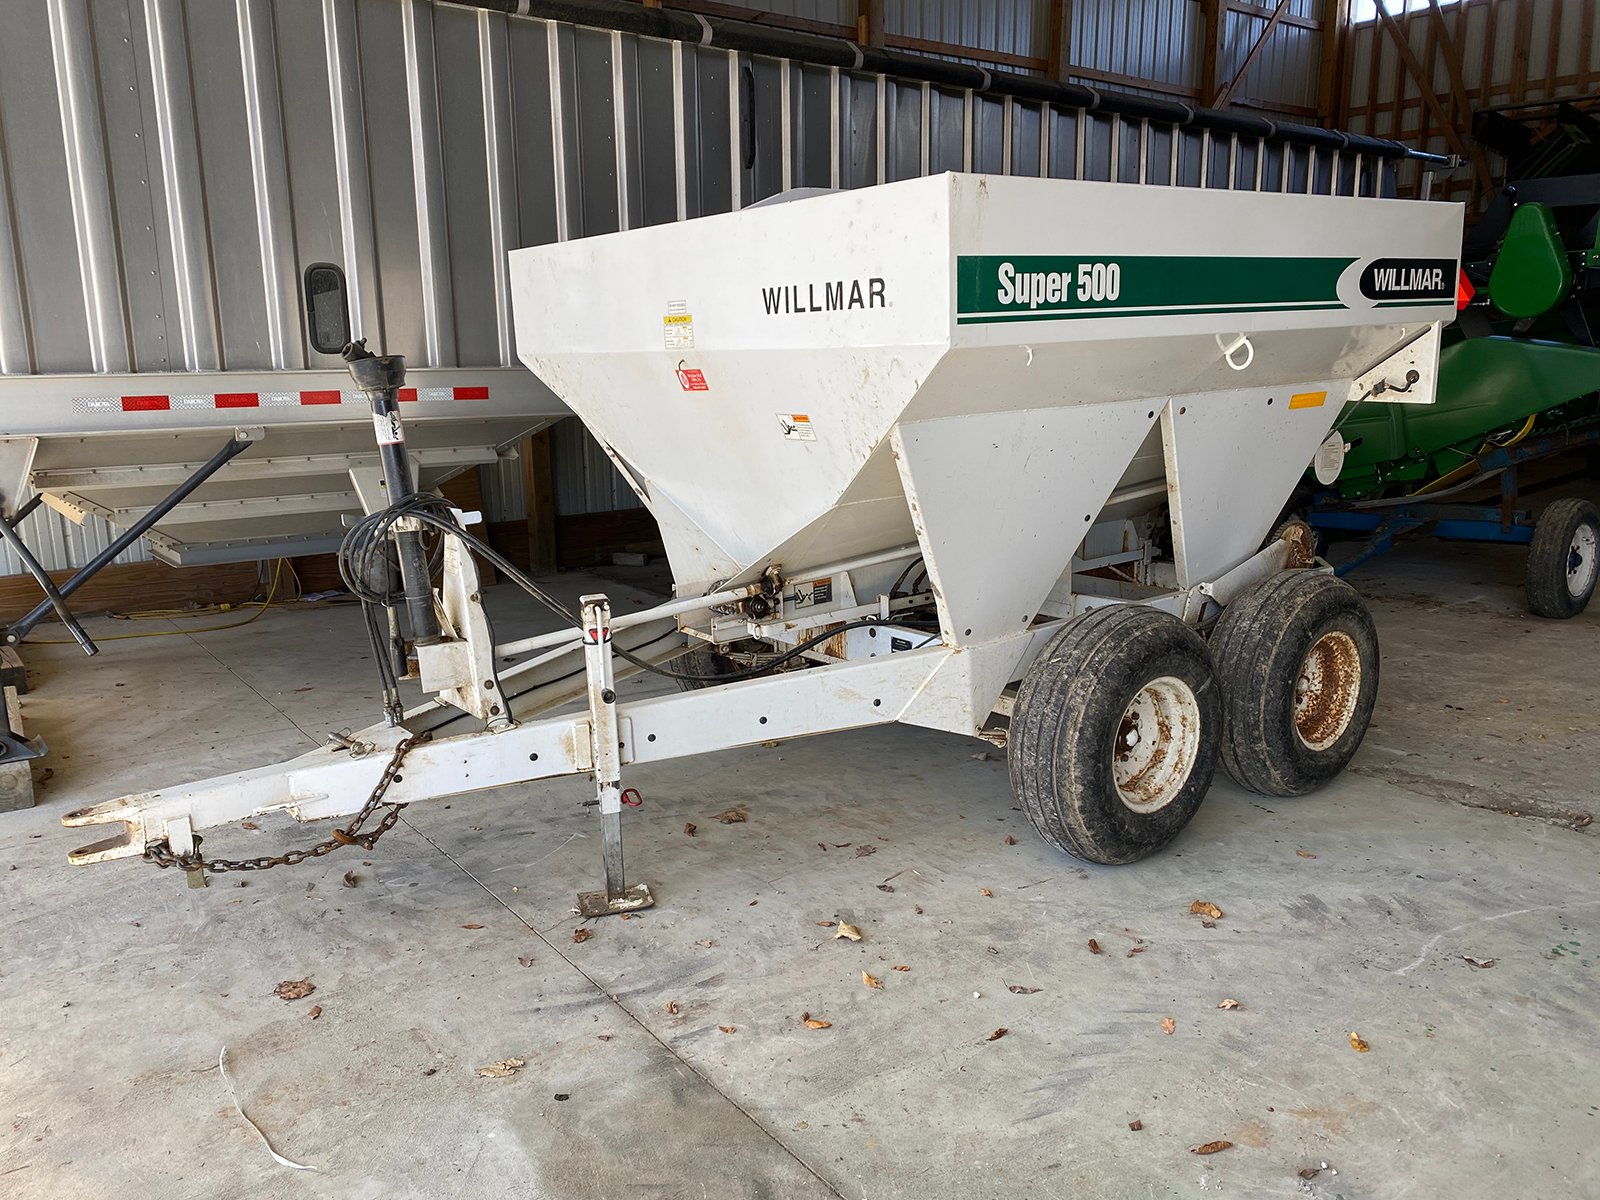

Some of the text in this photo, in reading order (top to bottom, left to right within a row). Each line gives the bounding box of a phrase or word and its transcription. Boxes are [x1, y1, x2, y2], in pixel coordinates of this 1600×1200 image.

[762, 277, 886, 315] WILLMAR
[997, 262, 1120, 309] Super 500
[1373, 268, 1443, 291] WILLMAR
